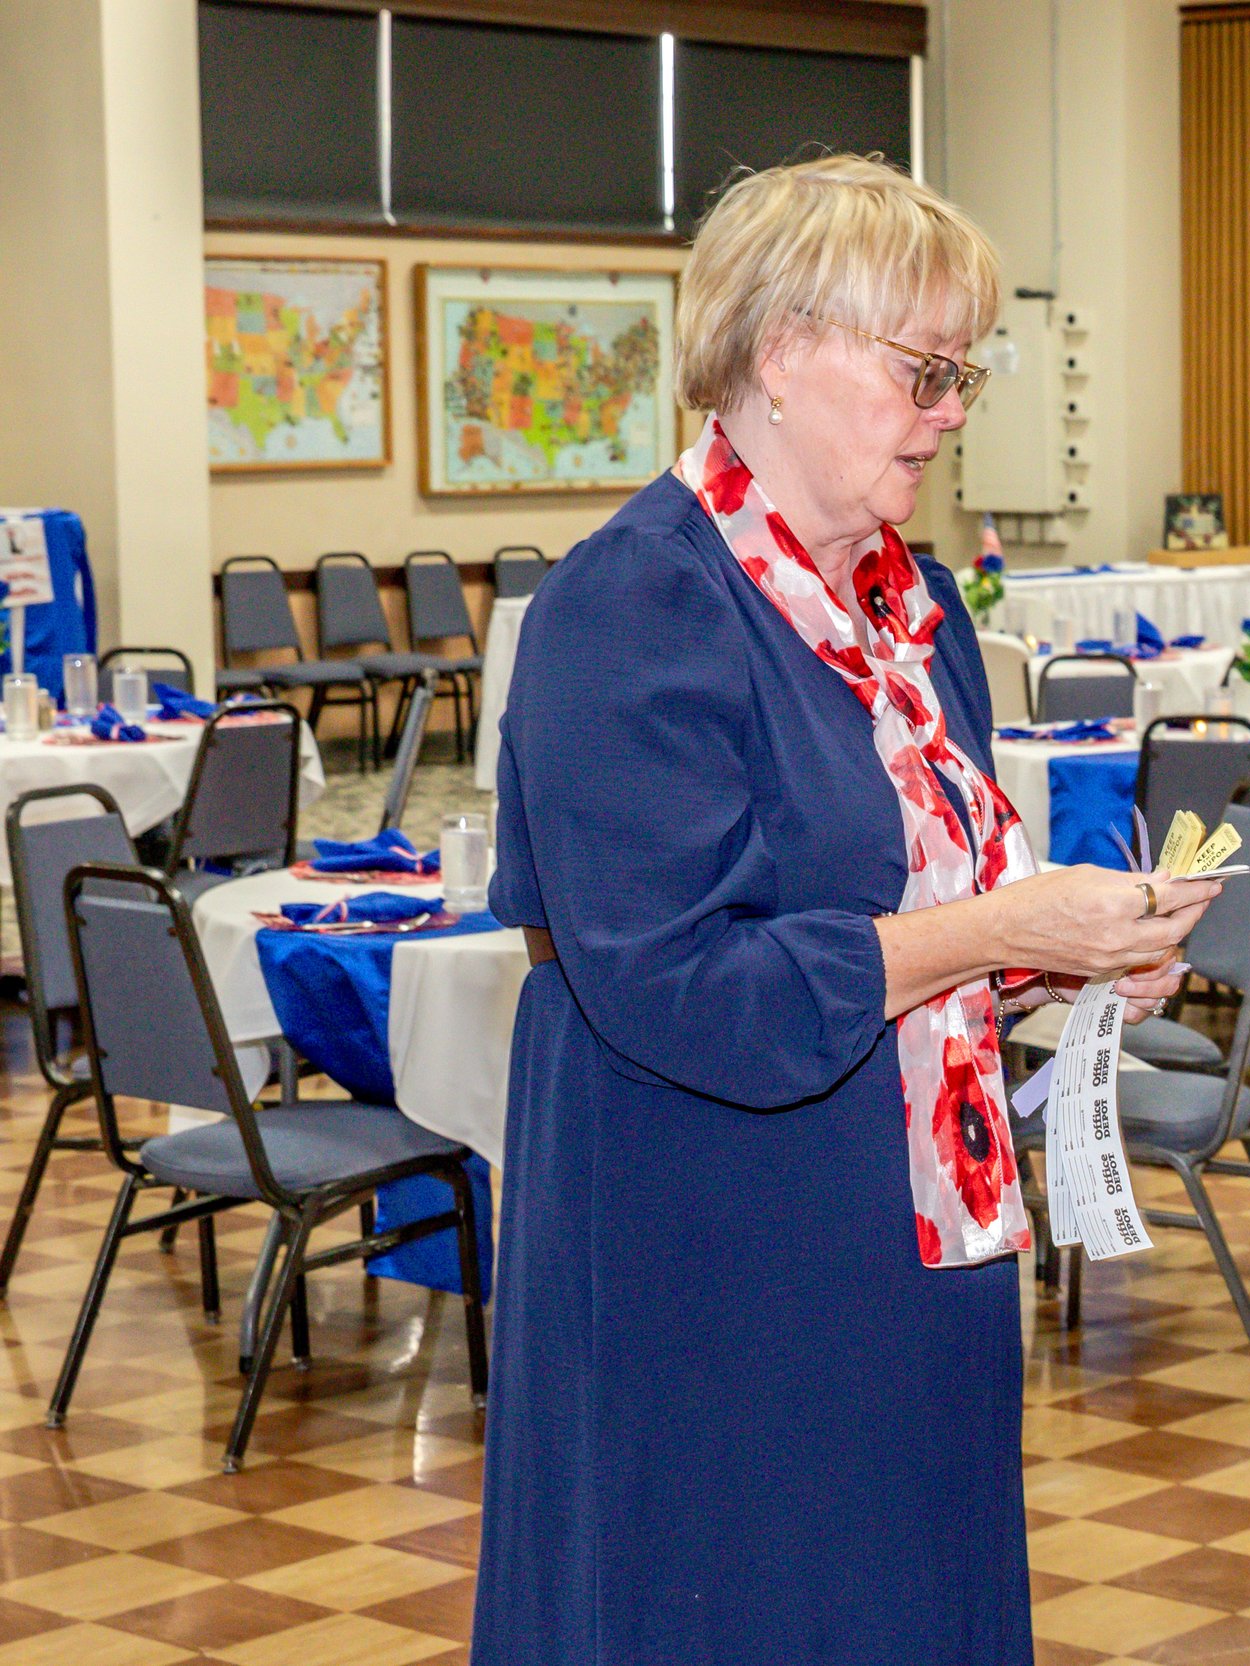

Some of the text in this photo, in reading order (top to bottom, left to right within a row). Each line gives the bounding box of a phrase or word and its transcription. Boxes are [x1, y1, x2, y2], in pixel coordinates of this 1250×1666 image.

[1164, 832, 1175, 856] KEEP
[1196, 842, 1216, 864] KEEP
[1198, 846, 1227, 873] OUPON
[1097, 1003, 1112, 1037] Office
[1105, 1001, 1118, 1035] DEPOT
[1092, 1049, 1104, 1087] Office
[1101, 1048, 1111, 1085] DEPOT
[1093, 1099, 1104, 1141] Office
[1101, 1099, 1111, 1138] DEPOT
[1101, 1153, 1116, 1195] Office
[1108, 1152, 1123, 1193] DEPOT
[1114, 1208, 1134, 1246] Office
[1121, 1207, 1142, 1244] DEPOT
